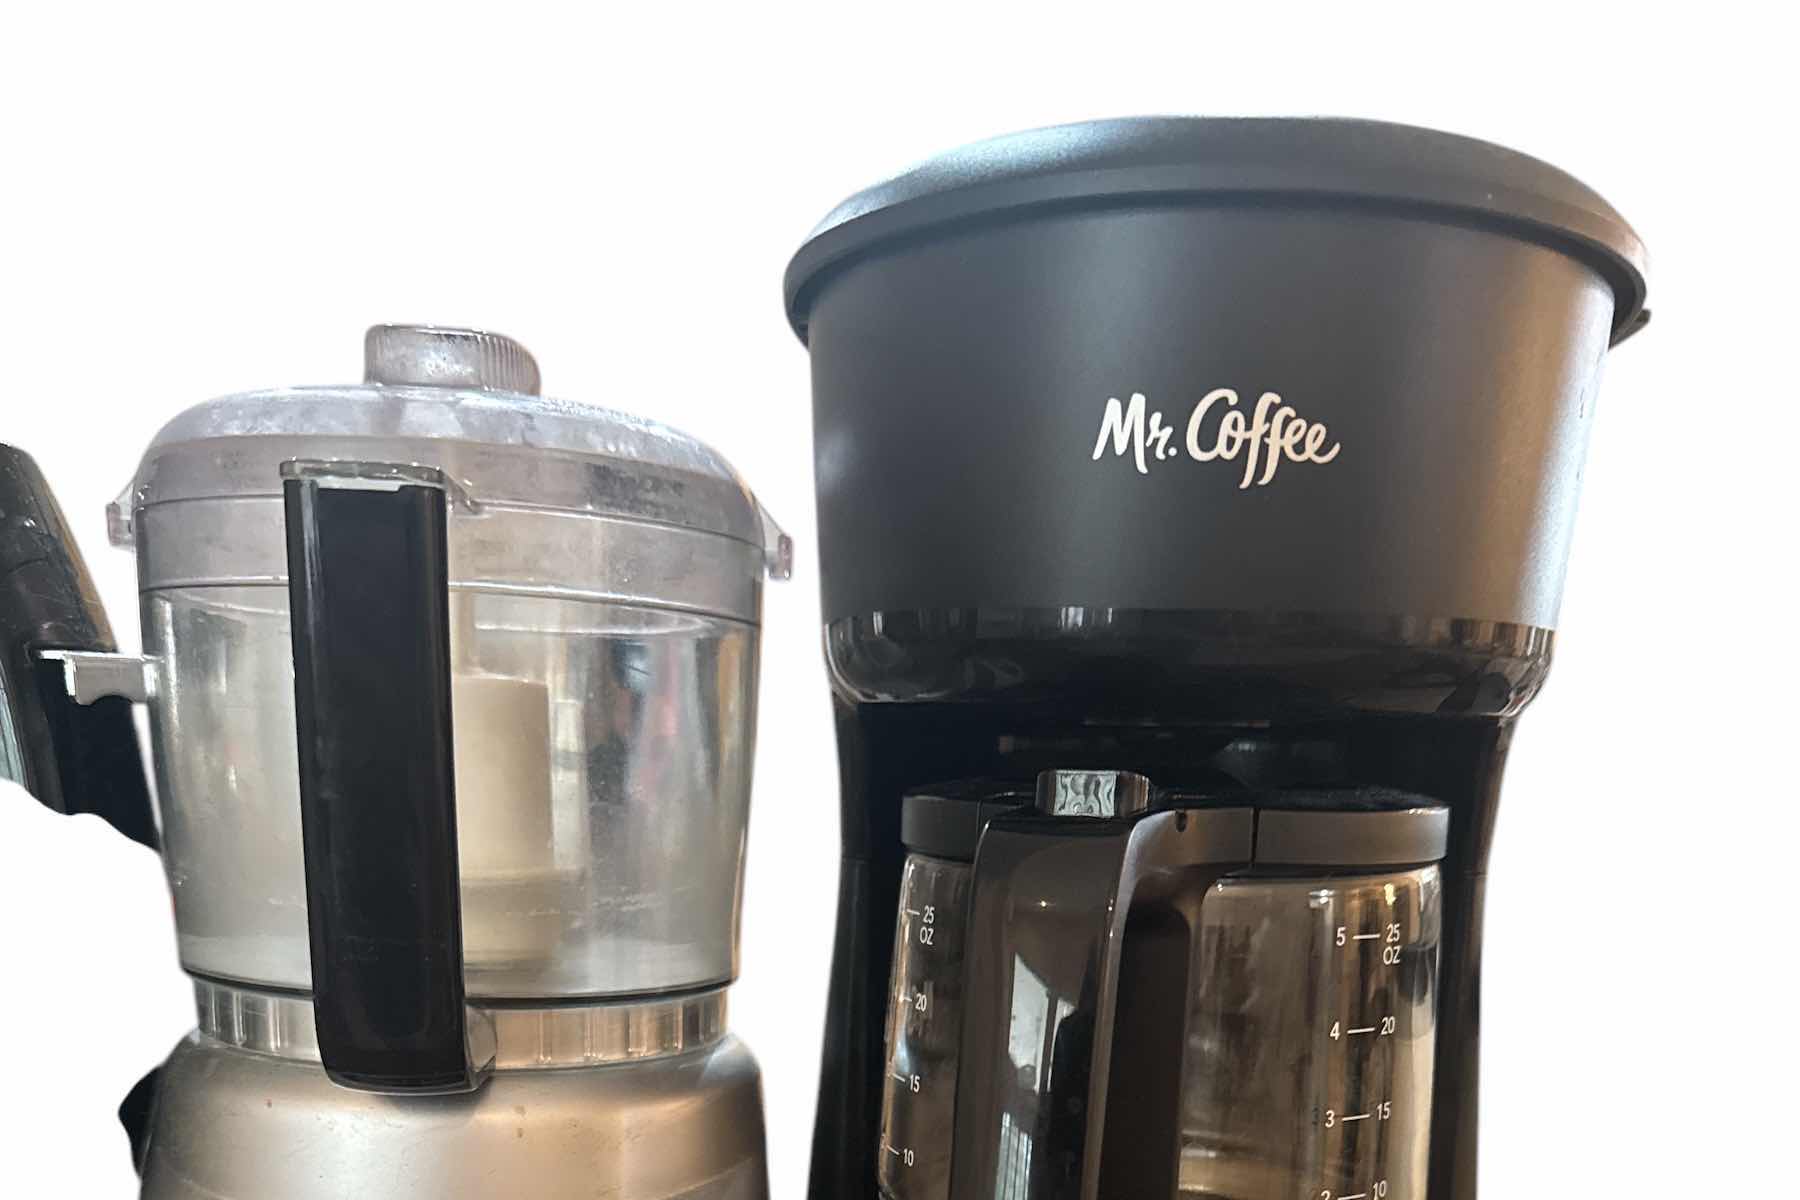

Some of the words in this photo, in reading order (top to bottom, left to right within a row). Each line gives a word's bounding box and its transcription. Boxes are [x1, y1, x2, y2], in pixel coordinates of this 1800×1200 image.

[1092, 392, 1178, 475] Mr.
[1186, 388, 1340, 490] Coffee
[922, 904, 935, 924] 25
[919, 926, 934, 946] OZ
[1335, 926, 1346, 947] 5
[1386, 922, 1401, 943] 25
[1383, 945, 1401, 965] OZ
[915, 992, 928, 1012] 20
[1329, 1021, 1340, 1041] 4
[1380, 1016, 1396, 1036] 20
[909, 1074, 920, 1093] 15
[1324, 1109, 1335, 1128] 3
[1376, 1101, 1392, 1121] 15
[903, 1148, 914, 1167] 10
[1372, 1180, 1387, 1199] 10
